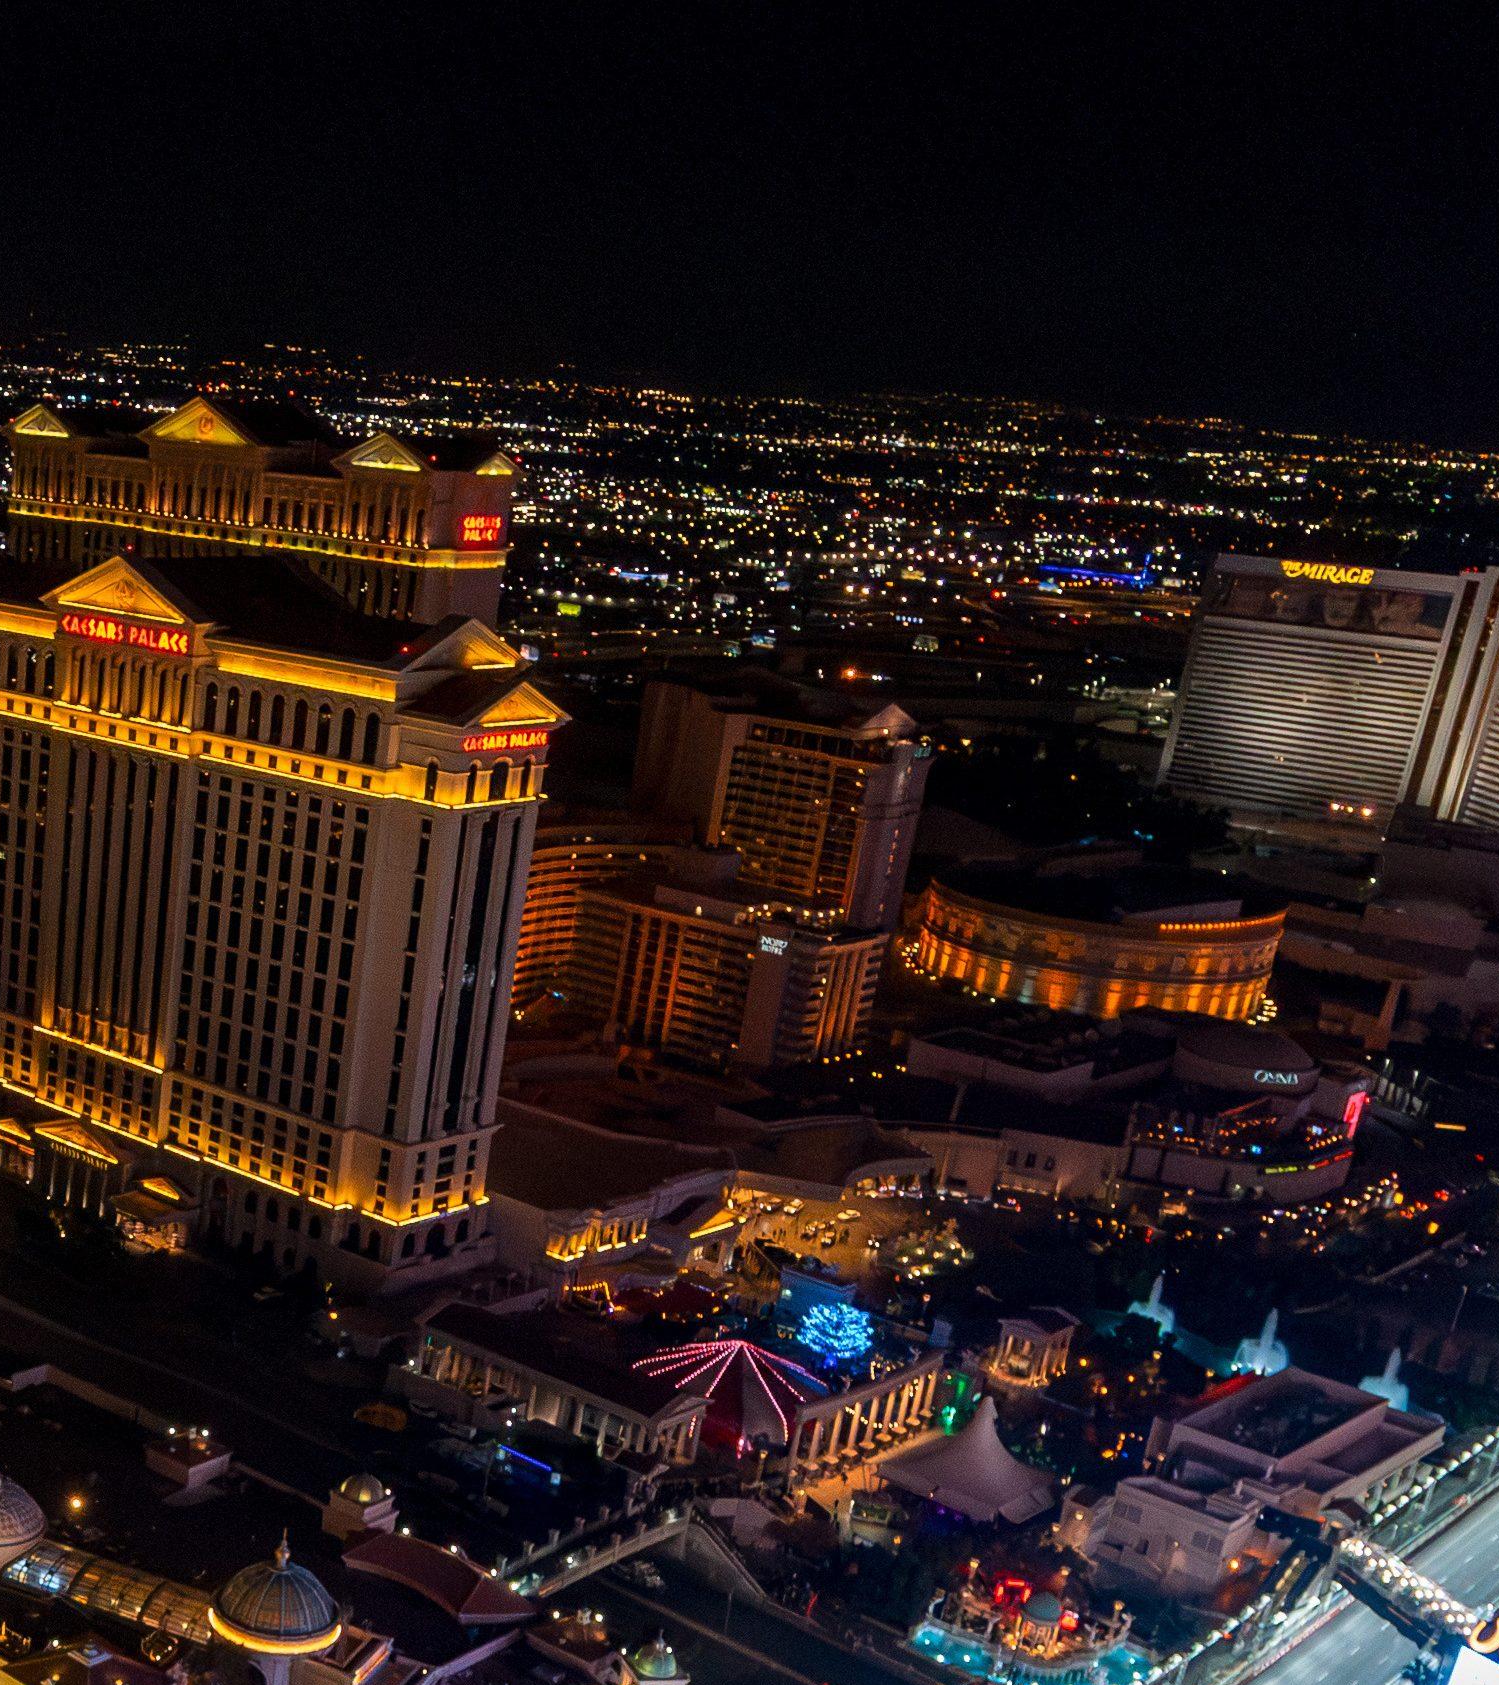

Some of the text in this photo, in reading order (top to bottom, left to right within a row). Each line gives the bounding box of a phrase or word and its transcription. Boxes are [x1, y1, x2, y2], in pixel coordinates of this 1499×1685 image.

[1285, 562, 1375, 585] MIRAGE
[61, 614, 189, 654] CAESARS PALACE
